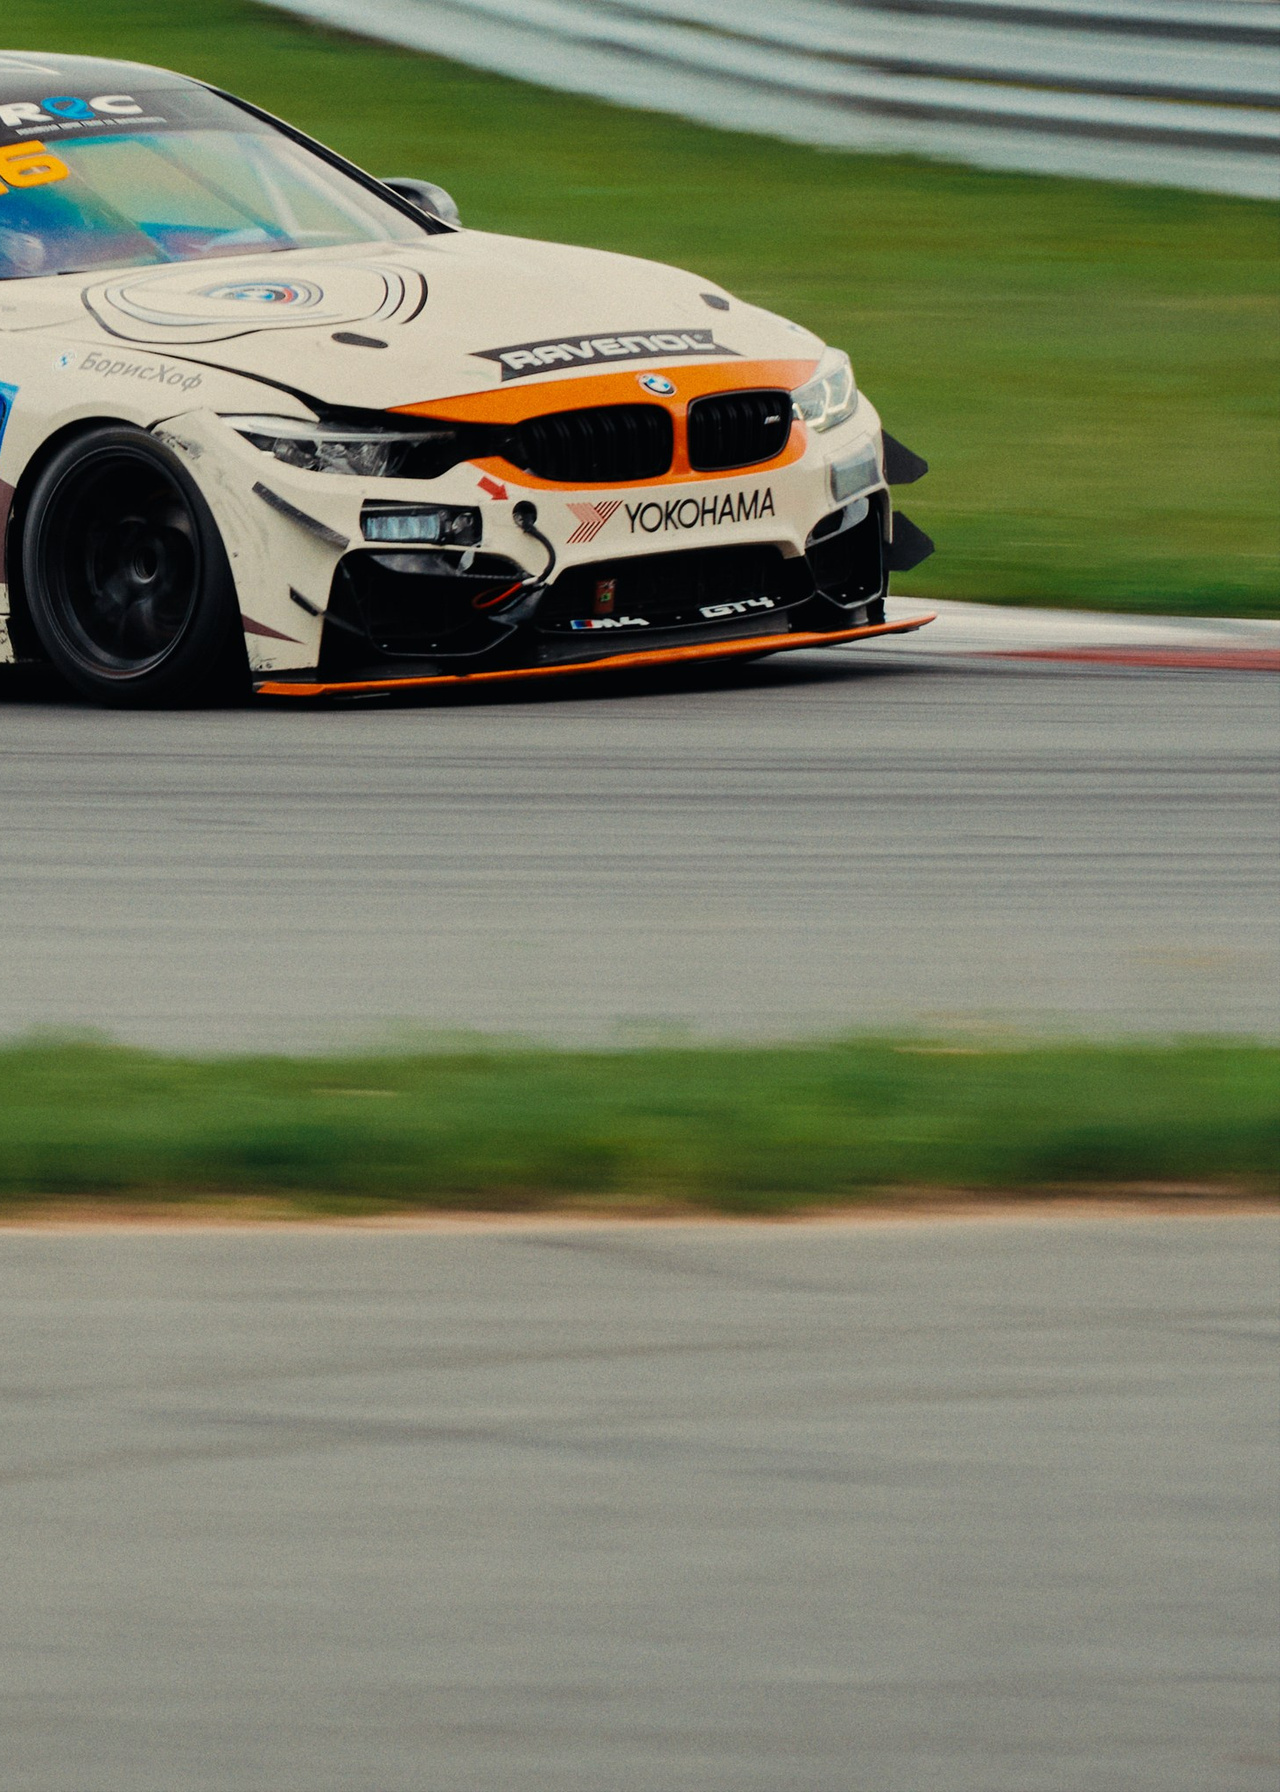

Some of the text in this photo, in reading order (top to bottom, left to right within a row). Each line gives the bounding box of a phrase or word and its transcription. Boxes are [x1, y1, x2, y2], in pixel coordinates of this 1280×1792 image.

[500, 334, 716, 370] RAVENOL
[78, 352, 203, 392] БорисХоф
[625, 487, 775, 533] YOKOHAMA
[699, 596, 775, 618] GT4
